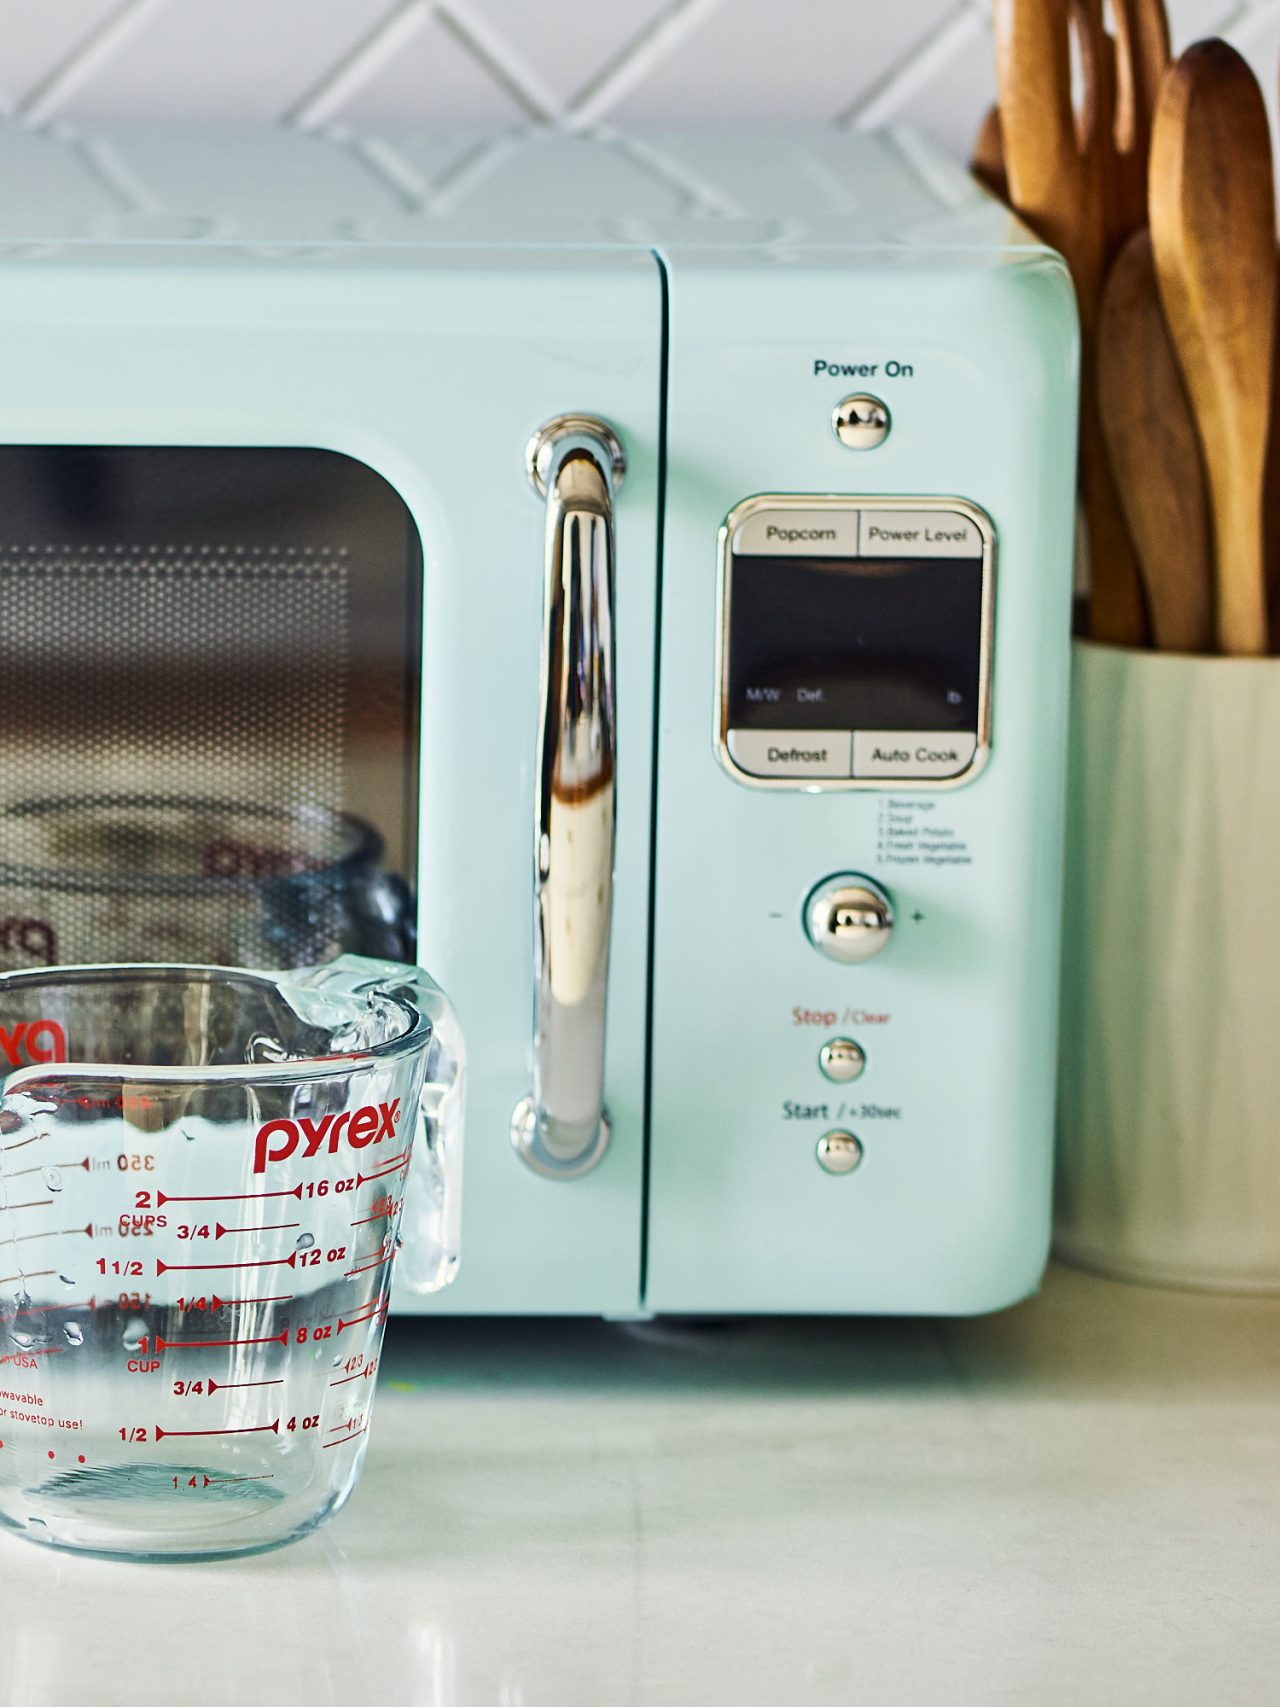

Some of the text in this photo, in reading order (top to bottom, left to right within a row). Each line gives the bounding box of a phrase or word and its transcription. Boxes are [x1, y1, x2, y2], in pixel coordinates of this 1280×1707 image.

[813, 359, 914, 378] Power On
[766, 526, 836, 543] Popcorn
[869, 527, 967, 542] Power Level
[767, 747, 827, 763] Defrost
[872, 747, 958, 762] Auto Cook
[792, 1007, 837, 1027] Stop
[782, 1101, 828, 1120] Start
[253, 1097, 402, 1174] pyrex
[305, 1178, 355, 1199] 16 oz
[135, 1190, 151, 1209] 2
[119, 1213, 168, 1229] CUPS
[176, 1224, 210, 1241] 3/4
[299, 1246, 347, 1268] 12 oz
[176, 1296, 207, 1313] 1/4
[295, 1325, 332, 1344] 8 oz
[137, 1336, 149, 1355] 1
[13, 1355, 38, 1370] USA
[127, 1359, 161, 1373] CUP
[173, 1380, 204, 1397] 3/4
[10, 1409, 55, 1428] stovetop
[58, 1419, 84, 1430] use!
[286, 1415, 320, 1432] 4 oz
[118, 1426, 147, 1443] 1/2
